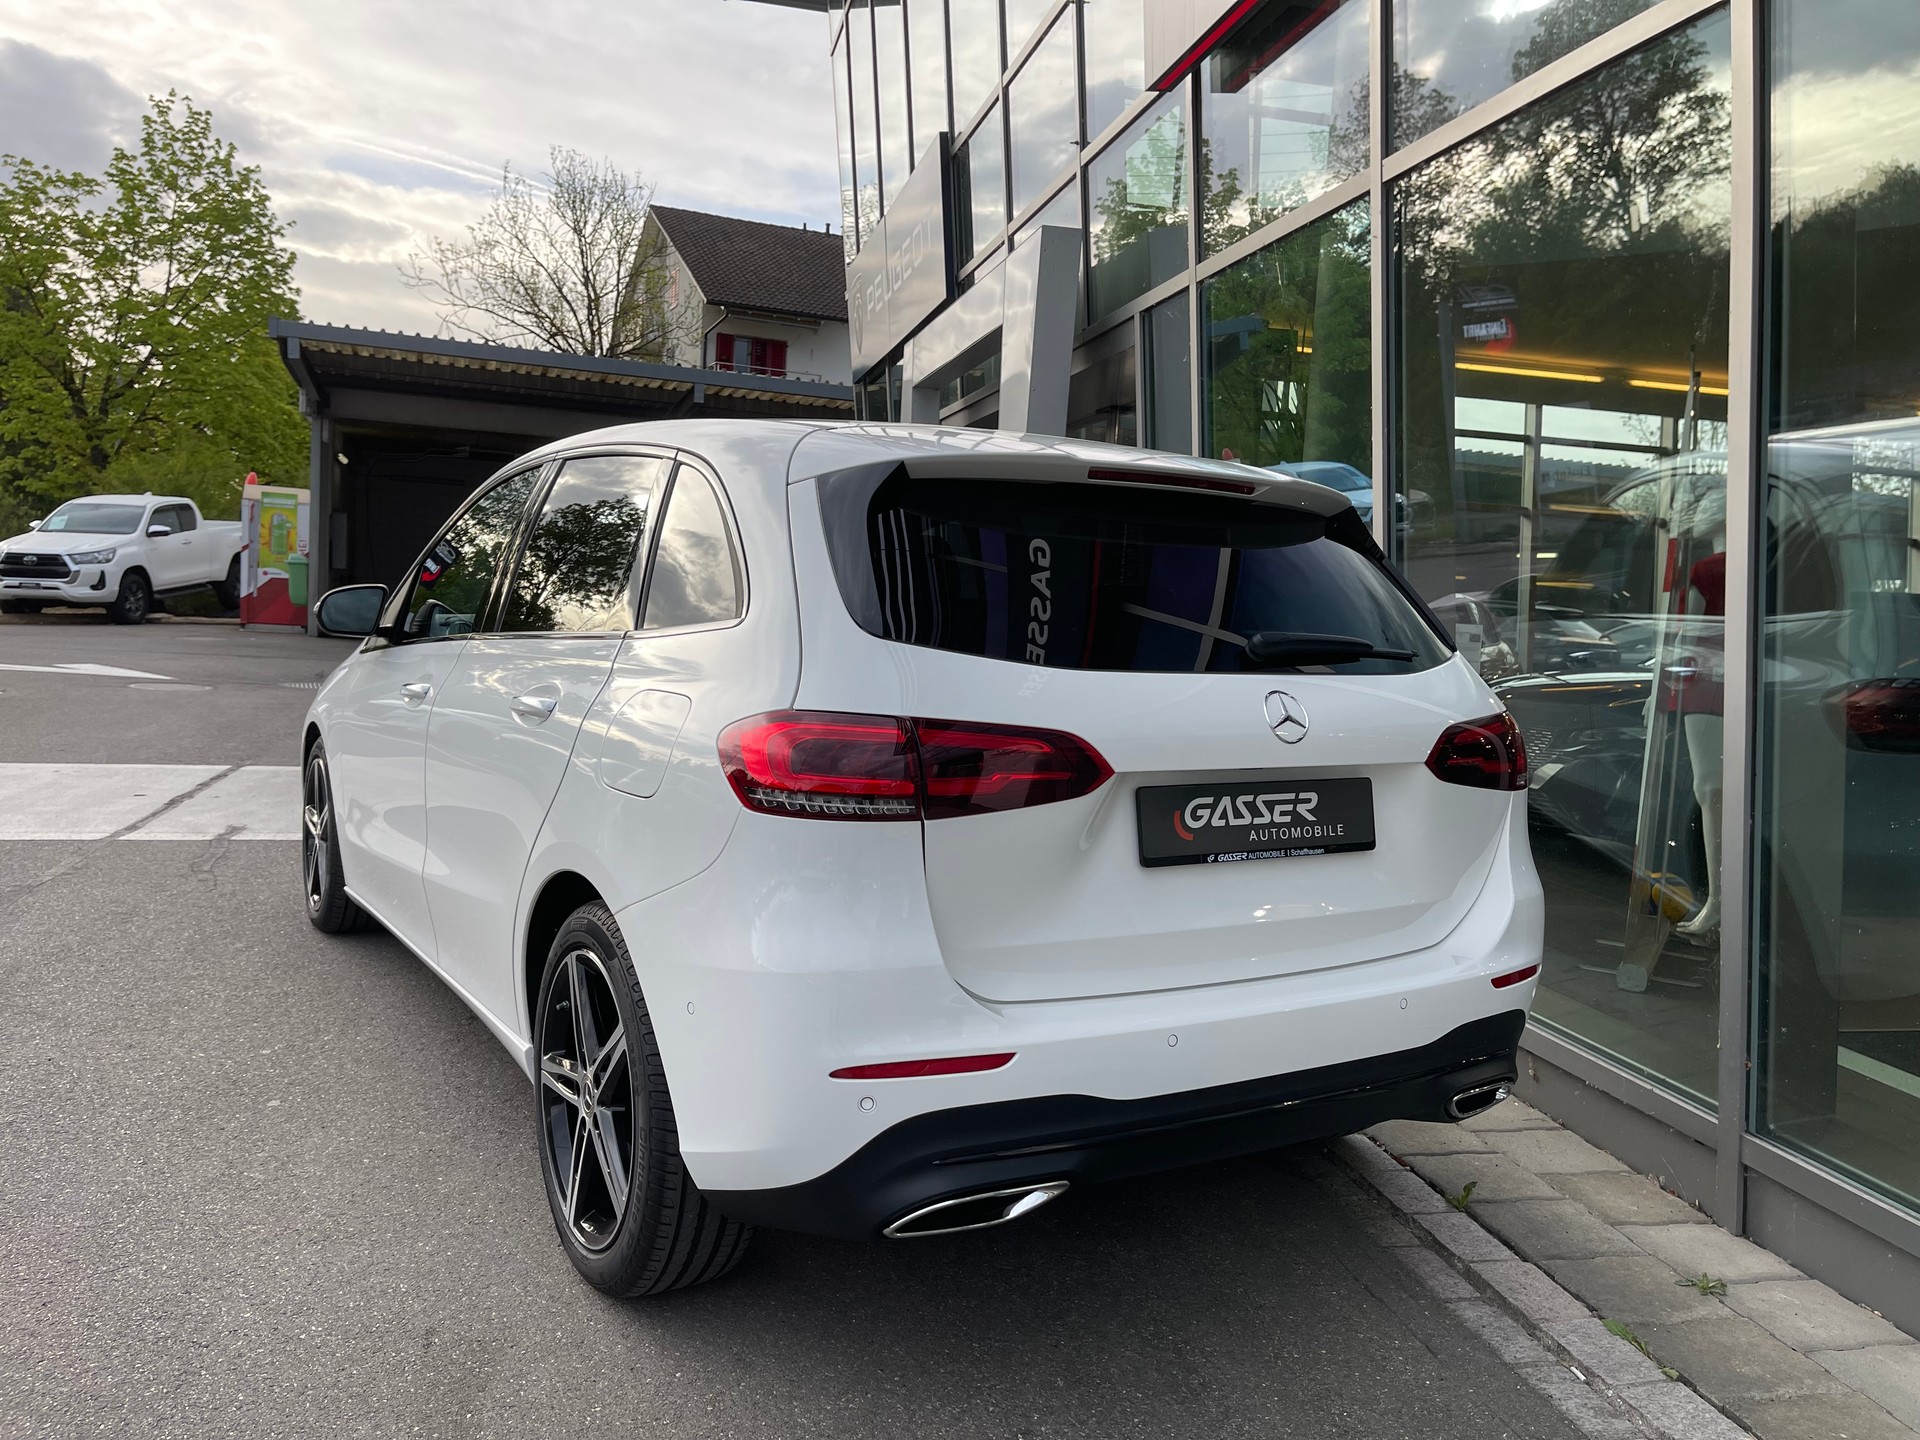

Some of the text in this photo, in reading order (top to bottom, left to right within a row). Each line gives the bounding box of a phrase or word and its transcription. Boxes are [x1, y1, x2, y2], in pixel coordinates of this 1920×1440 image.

[866, 211, 933, 321] PEUGEOT
[1185, 791, 1319, 829] GASSER
[1249, 824, 1345, 842] AUTOMOBILE
[1217, 852, 1249, 862] GASSER
[1248, 849, 1286, 860] AUTOMOBILE
[1290, 848, 1325, 856] Schaffhausen
